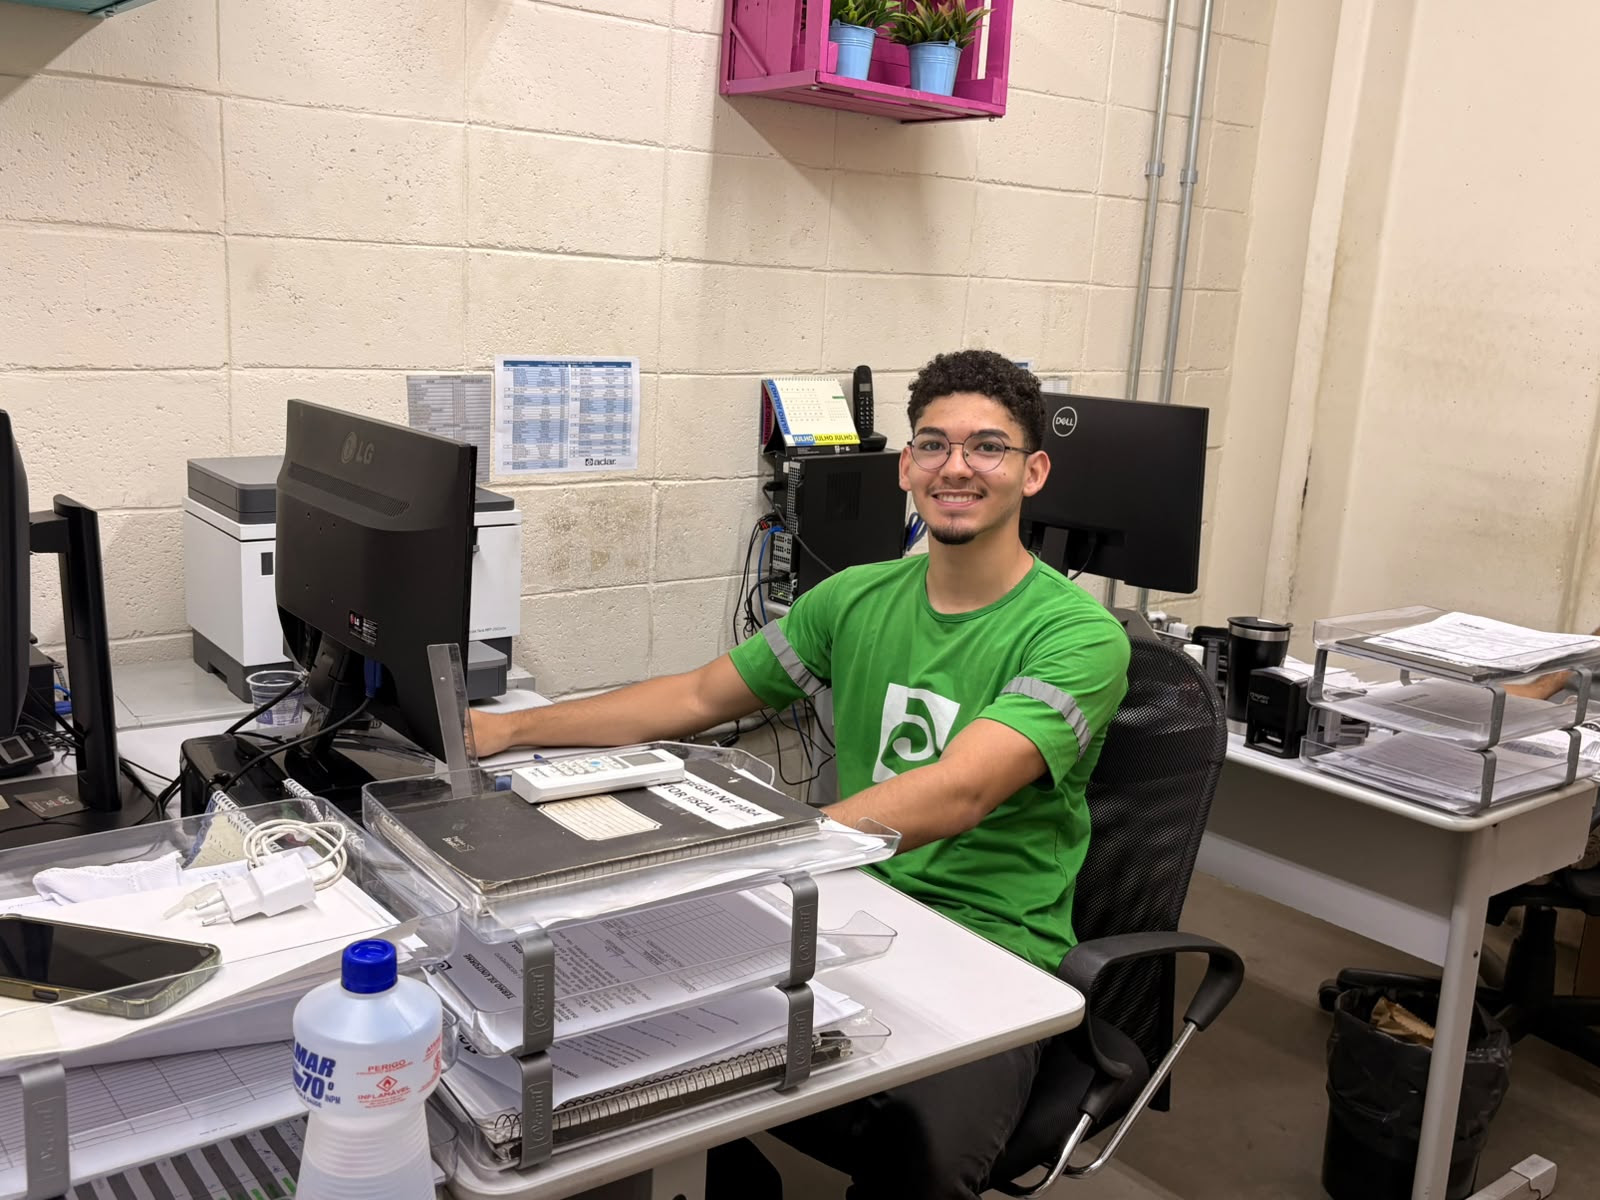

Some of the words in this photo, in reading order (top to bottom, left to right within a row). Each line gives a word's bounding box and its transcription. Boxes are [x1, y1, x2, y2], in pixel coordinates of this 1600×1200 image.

[1055, 416, 1074, 426] DELL
[834, 433, 854, 441] JULHO
[355, 440, 376, 464] LG
[367, 1059, 407, 1073] PERIGO
